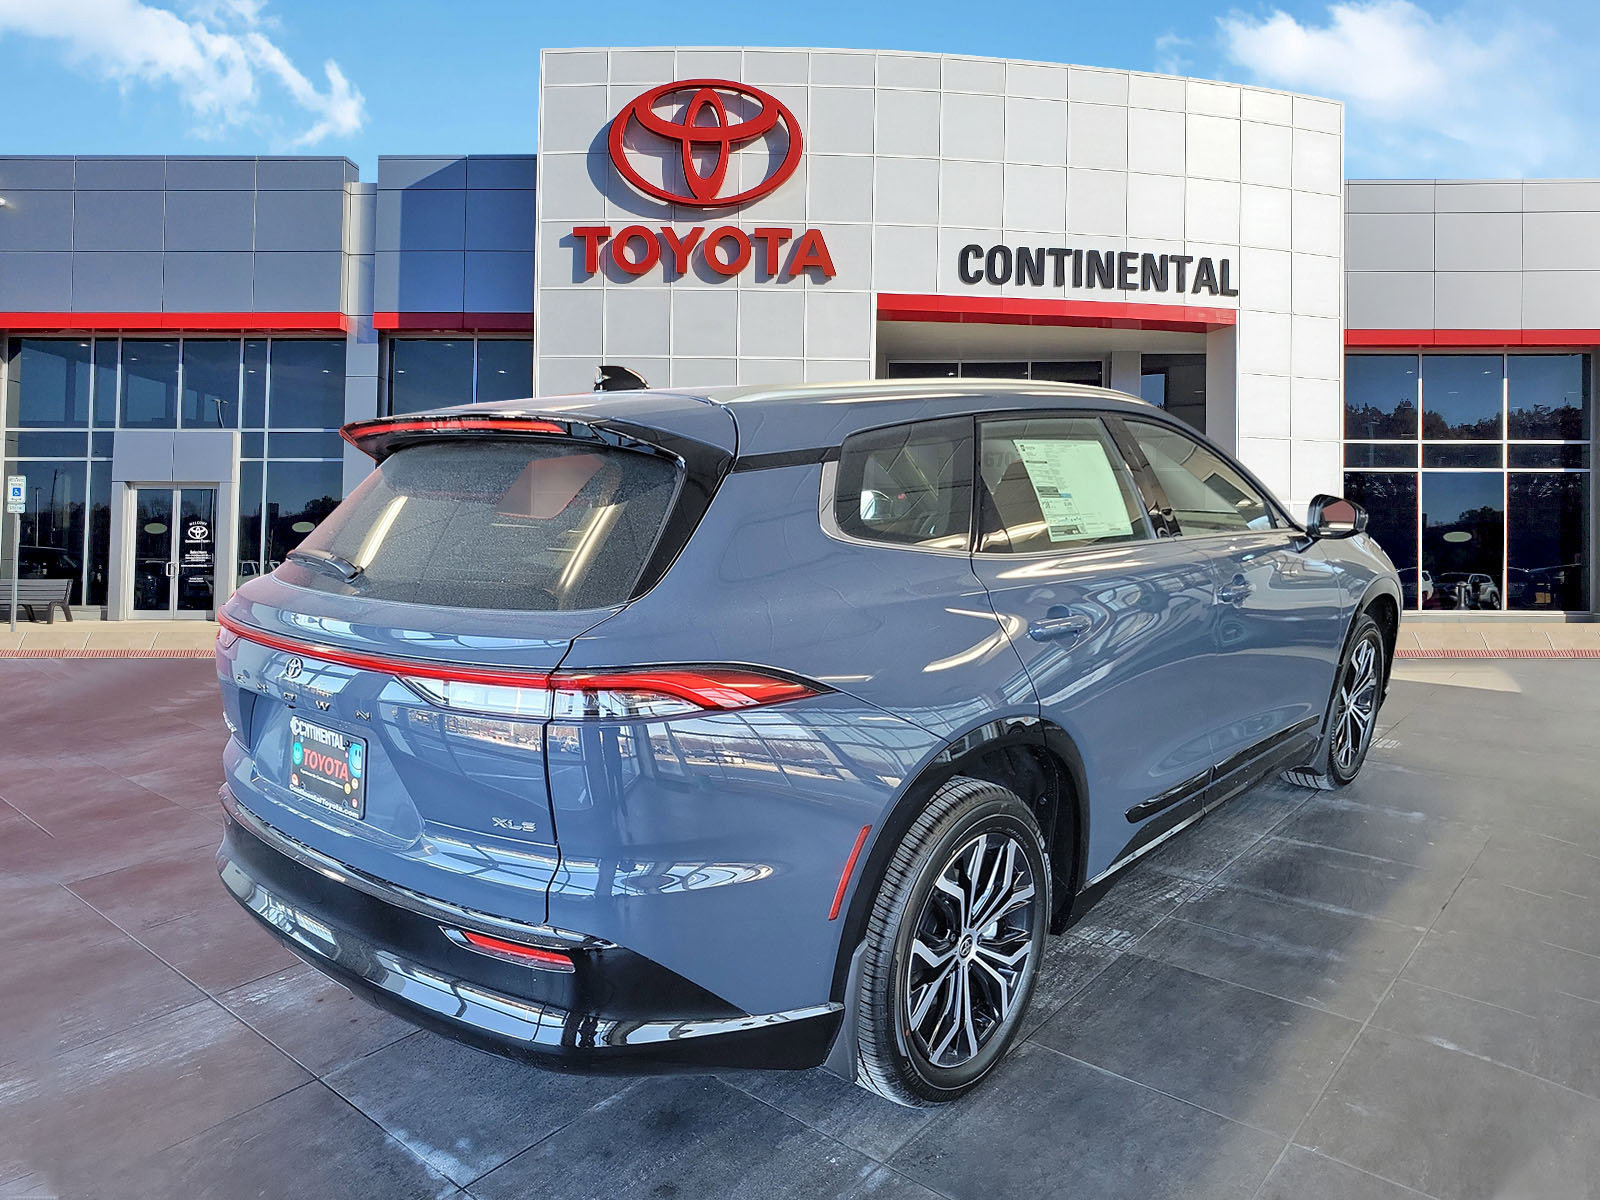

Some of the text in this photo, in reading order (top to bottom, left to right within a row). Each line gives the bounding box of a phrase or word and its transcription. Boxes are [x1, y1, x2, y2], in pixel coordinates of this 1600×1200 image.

[572, 224, 837, 277] TOYOTA
[958, 243, 1239, 297] CONTINENTAL
[303, 747, 349, 782] TOYOTA
[491, 816, 537, 832] XLE
